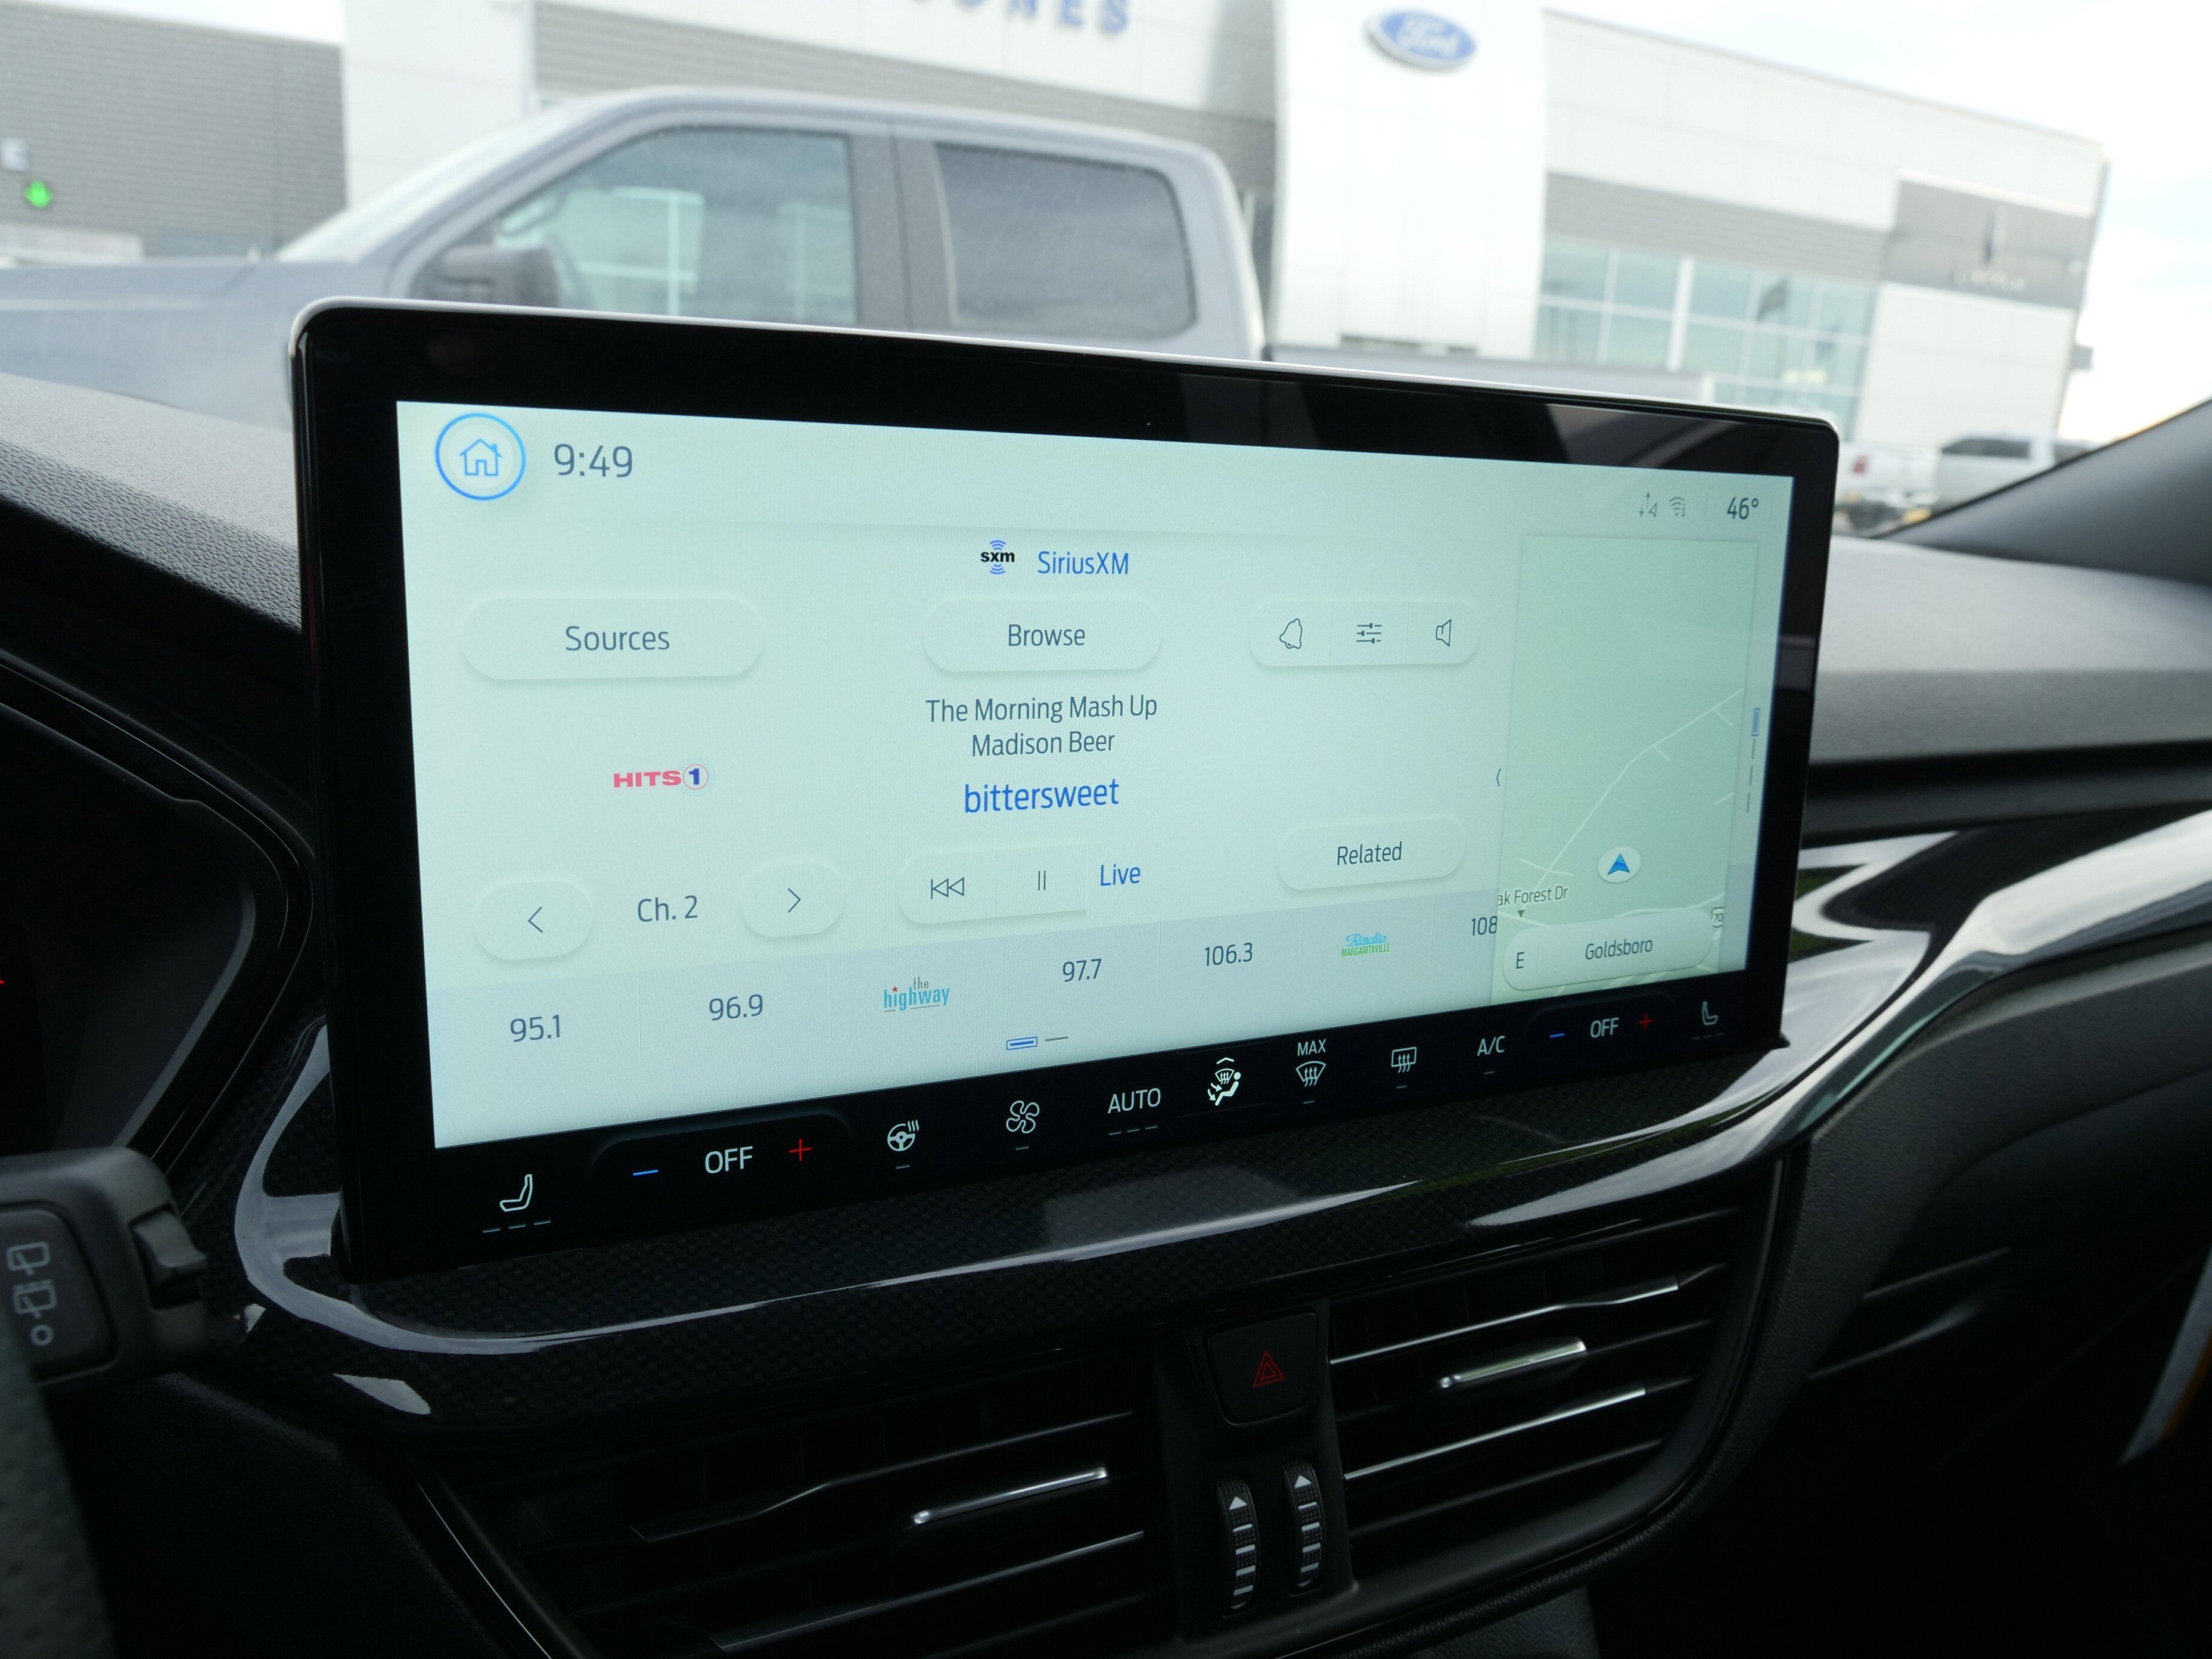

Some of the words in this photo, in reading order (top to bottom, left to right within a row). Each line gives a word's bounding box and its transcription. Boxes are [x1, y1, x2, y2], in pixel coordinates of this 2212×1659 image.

[554, 443, 633, 478] 9:49
[1726, 496, 1759, 520] 46°
[980, 551, 1015, 563] sxm
[1037, 551, 1129, 575] SiriusXM
[566, 626, 670, 651] Sources
[1008, 624, 1085, 647] Browse
[925, 698, 968, 722] The
[975, 697, 1063, 723] Morning
[1070, 694, 1123, 718] Mash
[1130, 694, 1157, 720] Up
[973, 732, 1062, 757] Madison
[1069, 731, 1116, 753] Beer
[613, 770, 681, 788] HITS
[688, 768, 700, 785] 1
[965, 778, 1120, 813] bittersweet
[1337, 841, 1402, 866] Related
[1100, 863, 1141, 887] Live
[1514, 887, 1552, 905] Forest
[1555, 886, 1568, 900] Dr
[637, 897, 676, 922] Ch.
[684, 894, 698, 919] 2
[1341, 943, 1391, 957] MARGARITAVILLE
[1345, 931, 1387, 947] Radio
[1585, 939, 1653, 961] Goldsboro
[1204, 942, 1253, 967] 106.3
[1515, 952, 1525, 970] E
[1062, 958, 1102, 983] 97.7
[913, 976, 929, 990] the
[709, 994, 763, 1021] 96.9
[883, 986, 950, 1011] highway
[510, 1014, 561, 1042] 95.1
[1590, 1017, 1620, 1038] OFF
[1297, 1039, 1326, 1057] MAX
[1477, 1035, 1505, 1057] A/C
[1107, 1088, 1161, 1114] AUTO
[704, 1145, 753, 1174] OFF
